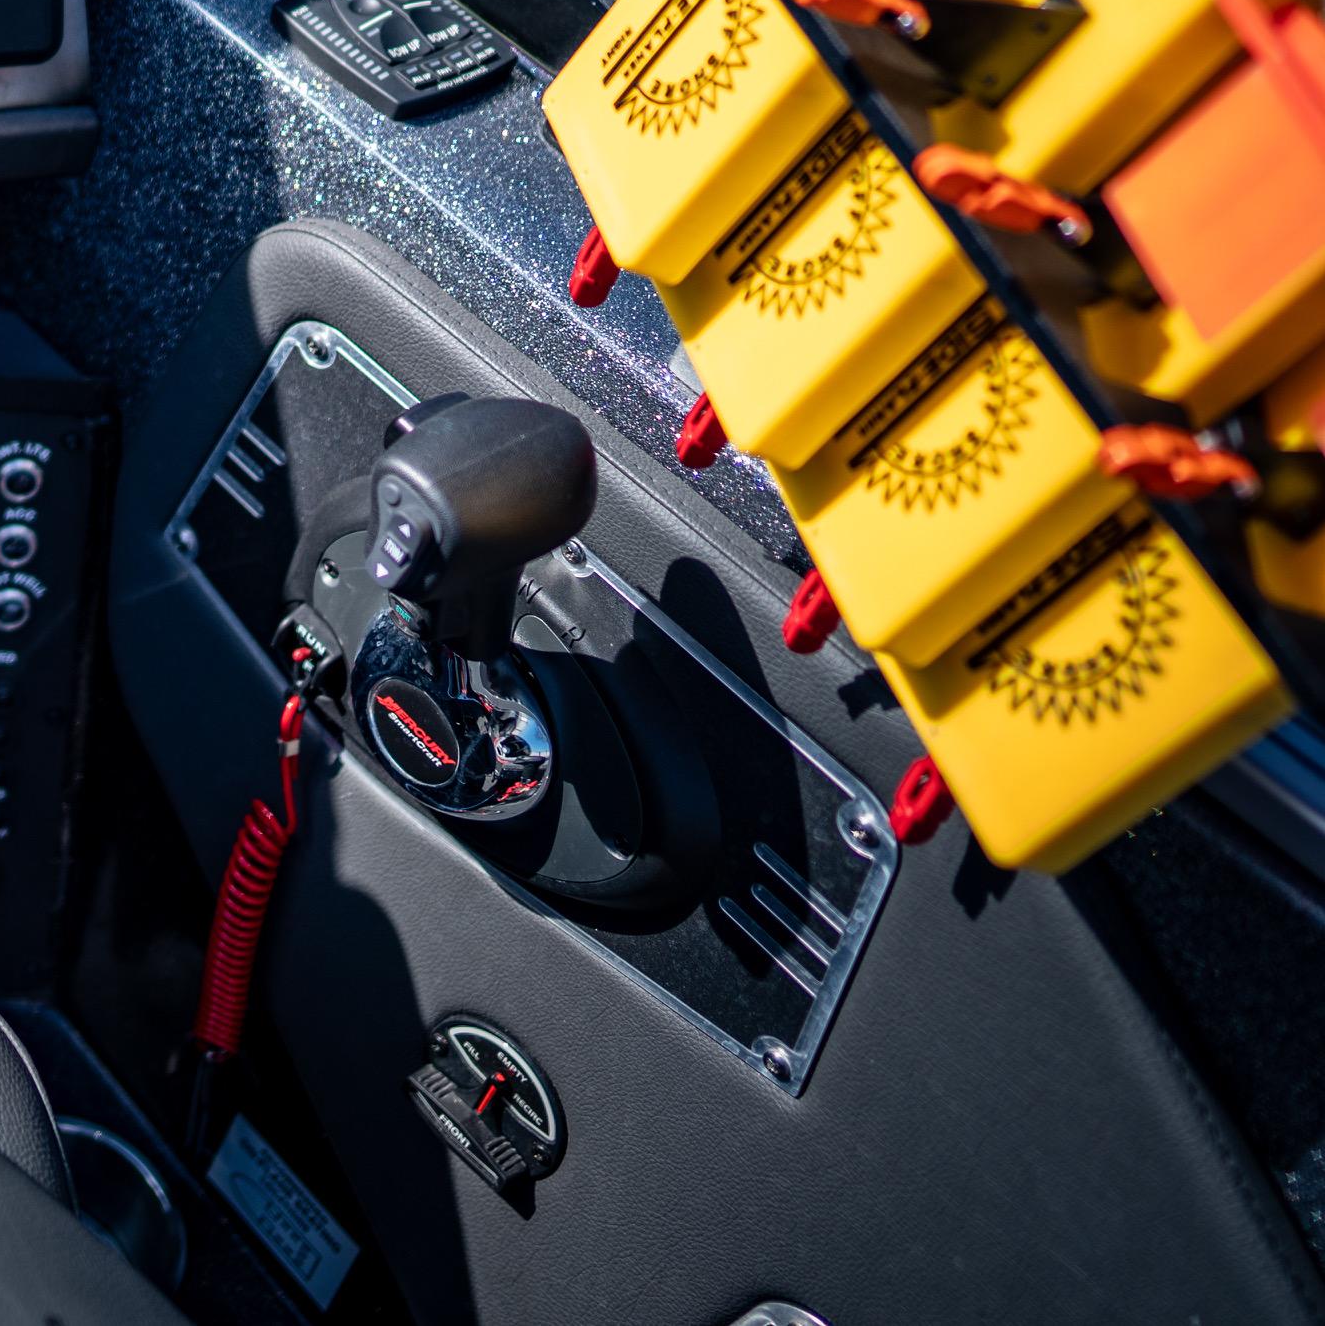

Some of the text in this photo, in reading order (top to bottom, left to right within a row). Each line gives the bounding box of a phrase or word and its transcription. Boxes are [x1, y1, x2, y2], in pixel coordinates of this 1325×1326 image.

[406, 38, 421, 52] UP
[445, 23, 460, 38] UP
[600, 27, 633, 67] RIGHT
[650, 53, 721, 99] SHORE
[4, 507, 37, 522] ACC
[517, 578, 543, 604] N
[296, 624, 327, 656] RUN
[560, 625, 586, 651] R
[376, 696, 456, 765] MERCURY
[388, 712, 443, 767] SmartCraft
[464, 1041, 480, 1061] FILL
[497, 1051, 528, 1083] EMPTY
[512, 1093, 543, 1126] RECIRC
[439, 1114, 471, 1148] FRONT
